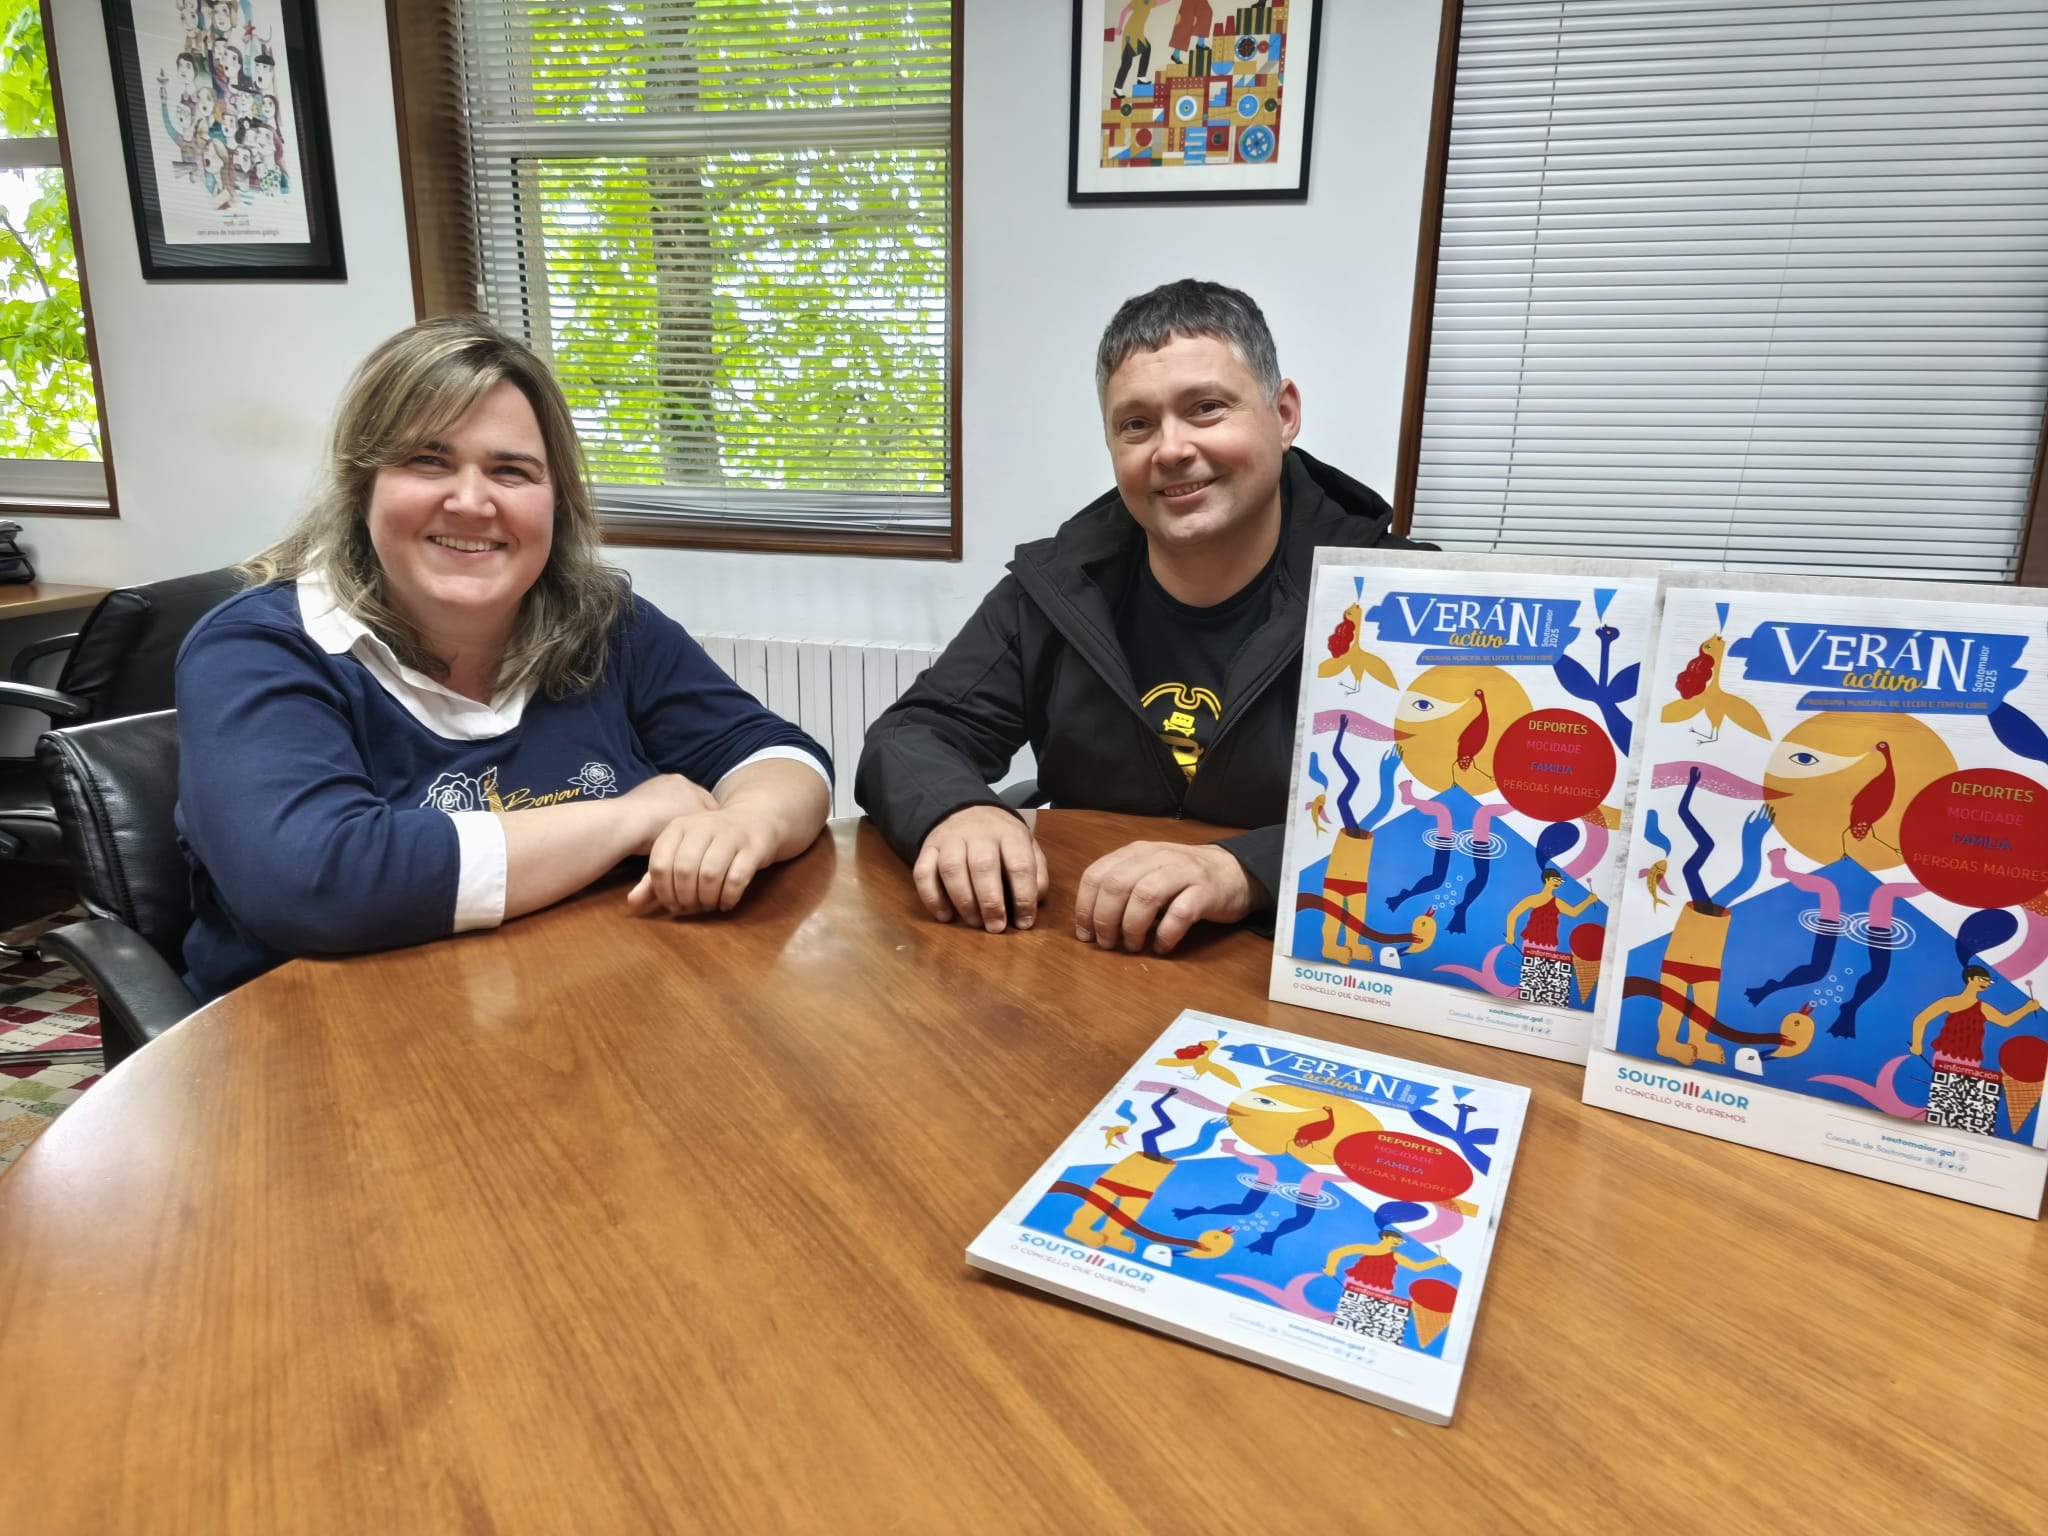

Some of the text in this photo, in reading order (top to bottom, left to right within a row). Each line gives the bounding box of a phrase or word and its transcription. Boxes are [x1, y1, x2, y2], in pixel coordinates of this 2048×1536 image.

[1396, 596, 1543, 647] VERÁN
[1449, 630, 1507, 648] activo
[1551, 628, 1560, 648] 2025
[1771, 626, 1975, 692] VERÁN
[1843, 667, 1923, 693] activo
[1983, 670, 1998, 694] 2025
[1528, 720, 1588, 735] DEPORTES
[1526, 741, 1582, 754] MOCIDADE
[503, 787, 581, 810] Bonjour
[1503, 779, 1601, 799] PERSOAS MAIORES
[1951, 781, 2034, 803] DEPORTES
[1948, 807, 2024, 826] MOCIDADE
[1913, 852, 2048, 882] PERSOAS MAIORES
[1624, 1087, 1672, 1105] CONCELLO
[1674, 1099, 1693, 1110] QUE
[1695, 1105, 1747, 1124] QUEREMOS
[1377, 1134, 1443, 1155] DEPORTES
[1343, 1161, 1397, 1181] PERSOAS
